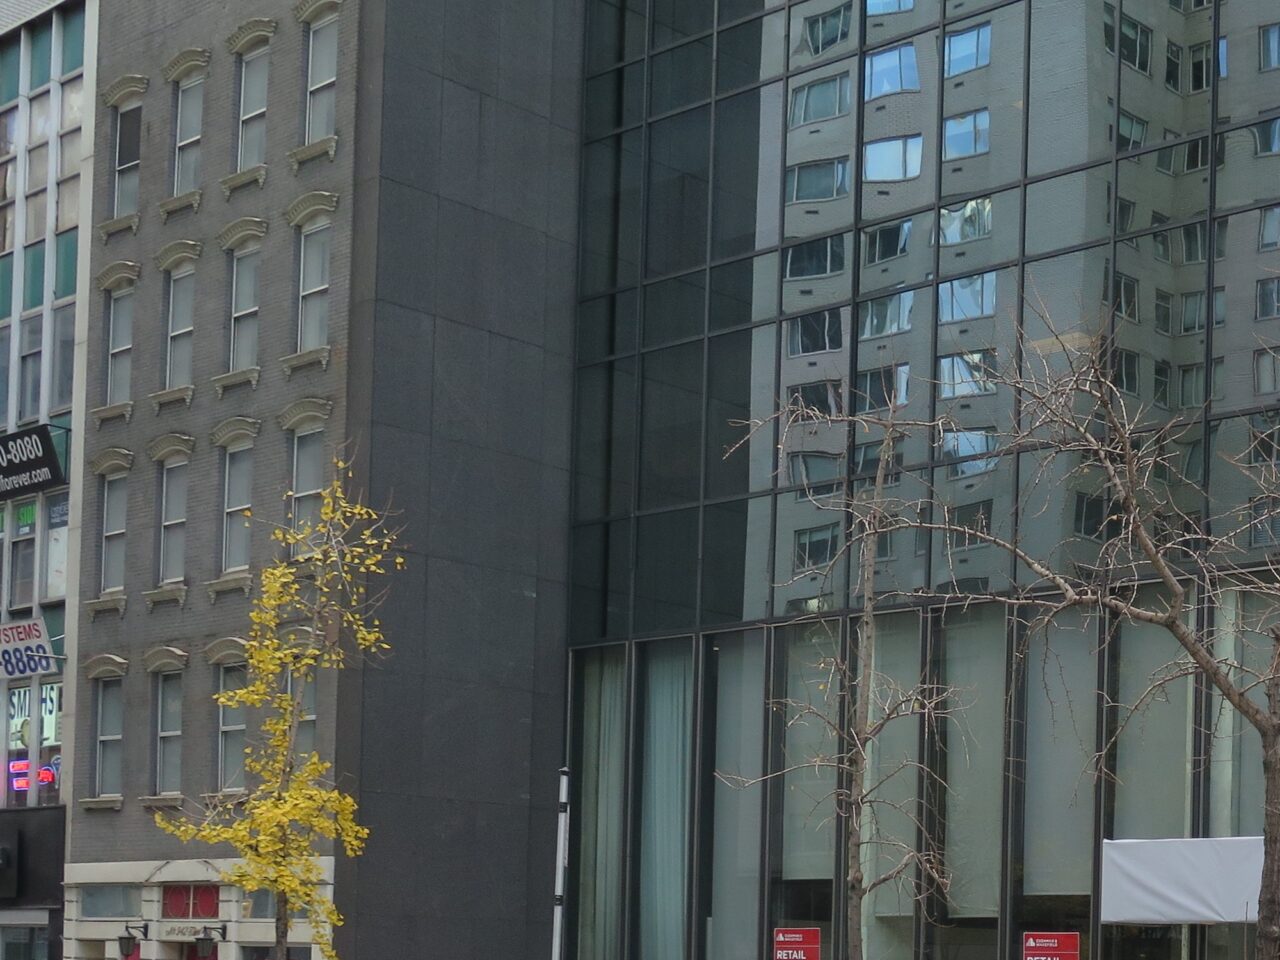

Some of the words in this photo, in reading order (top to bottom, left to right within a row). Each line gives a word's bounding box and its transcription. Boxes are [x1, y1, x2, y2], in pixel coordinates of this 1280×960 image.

[0, 467, 51, 491] forever.com
[0, 623, 42, 644] STEMS
[9, 685, 54, 720] SMIHS
[776, 950, 807, 960] RETAIL
